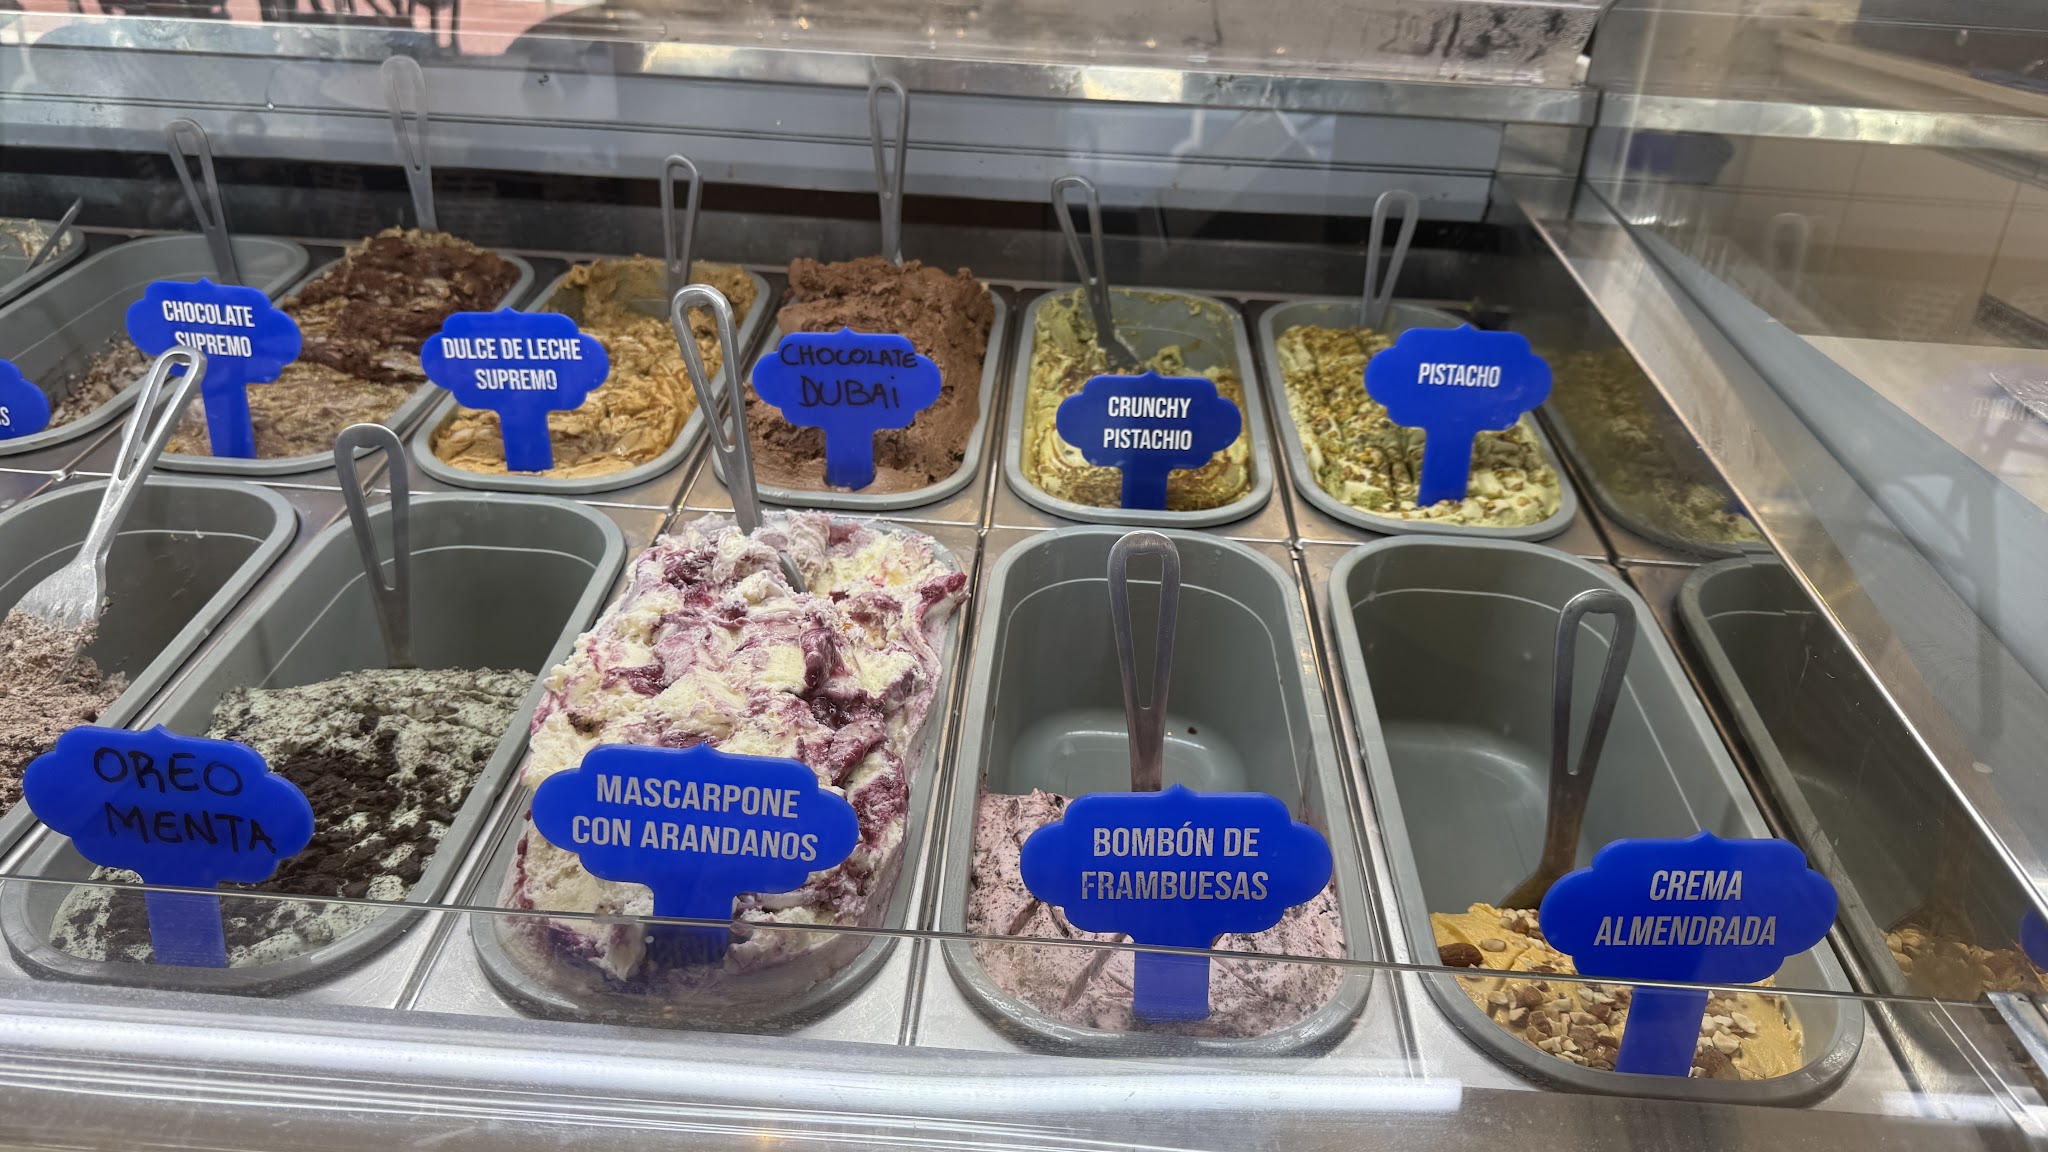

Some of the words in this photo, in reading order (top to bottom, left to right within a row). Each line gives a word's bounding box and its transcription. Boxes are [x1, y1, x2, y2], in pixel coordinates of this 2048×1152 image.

[161, 299, 256, 328] CHOCOLATE
[174, 330, 253, 358] SUPREMO
[441, 337, 499, 360] DULCE
[499, 337, 525, 360] DE
[526, 337, 583, 361] LECHE
[780, 343, 919, 369] CHOCOLATE
[474, 368, 558, 391] SUPREMO
[1417, 362, 1501, 388] PISTACHO
[1107, 395, 1192, 419] CRUNCHY
[1102, 427, 1193, 451] PISTACHIO
[93, 746, 243, 797] OREO
[597, 774, 801, 819] MASCARPONE
[104, 801, 276, 854] MENTA
[572, 815, 631, 847] CON
[640, 821, 818, 862] ARANDANOS
[1093, 821, 1214, 857] BOMBÓN
[1223, 827, 1261, 857] DE
[1081, 871, 1269, 900] FRAMBUESAS
[1649, 870, 1743, 901] CREMA
[1593, 916, 1776, 946] ALMENDRADA
